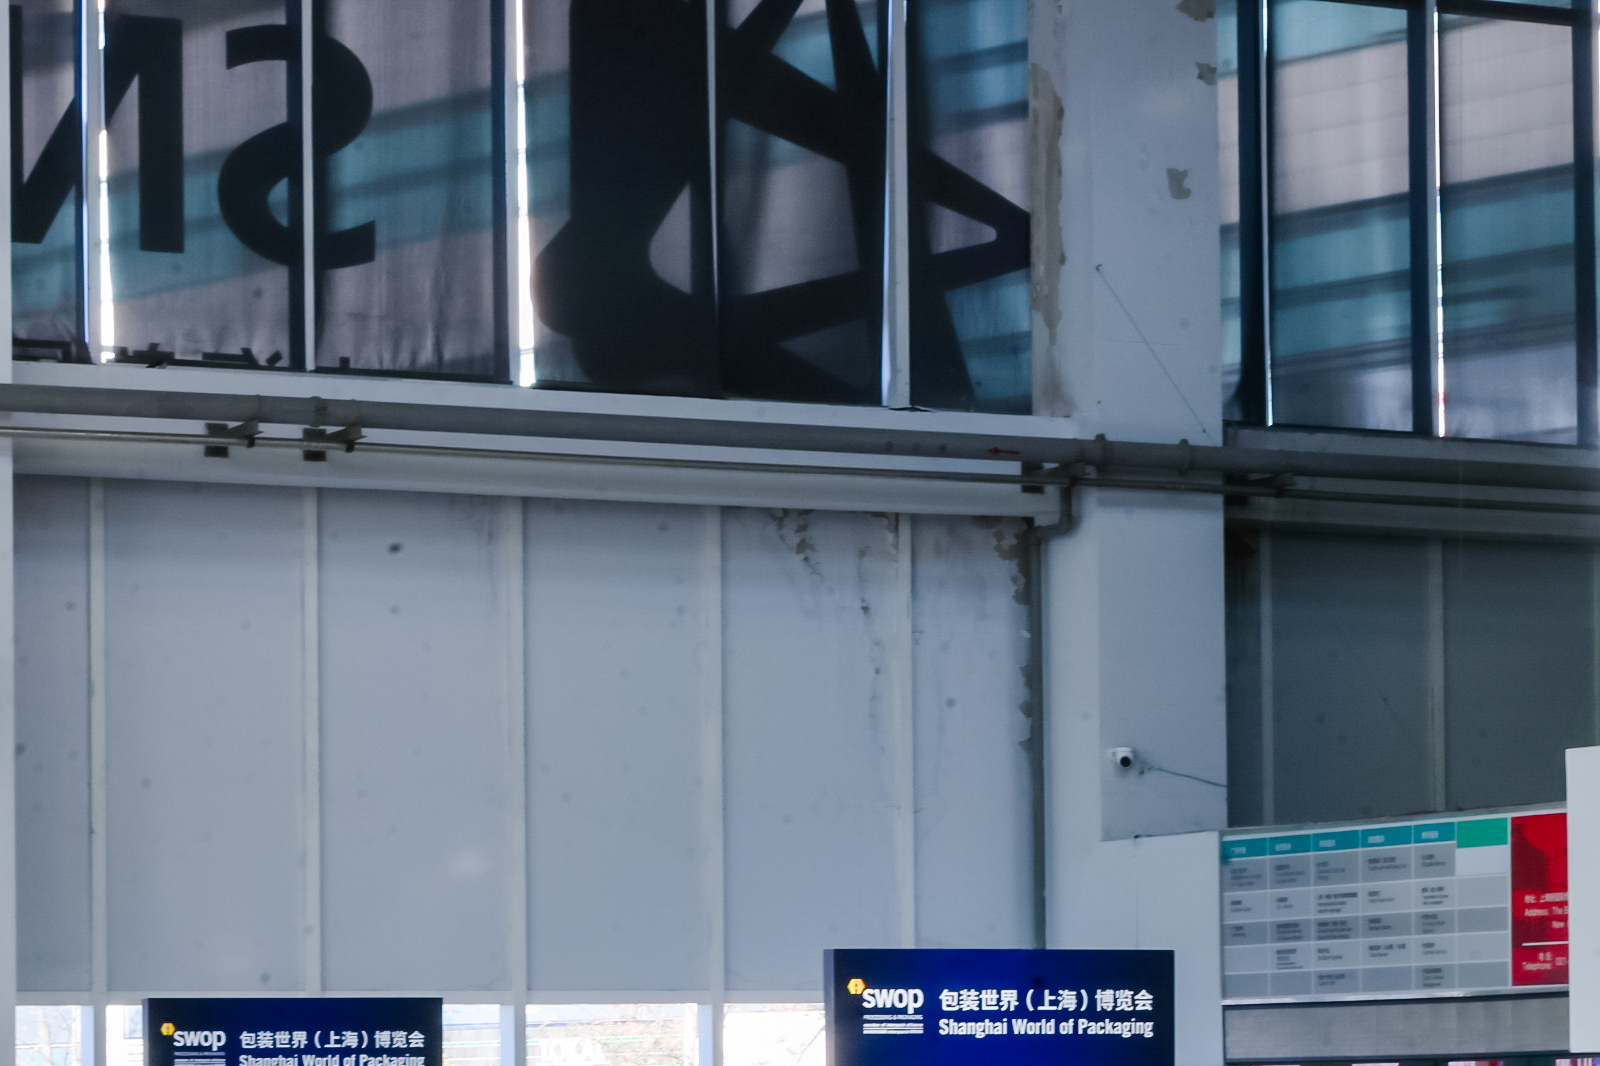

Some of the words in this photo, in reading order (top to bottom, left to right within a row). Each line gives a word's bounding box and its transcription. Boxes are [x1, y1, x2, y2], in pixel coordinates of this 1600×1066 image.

[862, 988, 924, 1014] swop
[938, 989, 1154, 1011] 包装世界（上海）博览会
[938, 1018, 1008, 1038] Shanghai
[1012, 1018, 1054, 1035] World
[1058, 1018, 1074, 1035] of
[1077, 1018, 1154, 1038] Packaging
[173, 1030, 226, 1052] swop
[239, 1030, 425, 1053] 包装世界（上海）博览会
